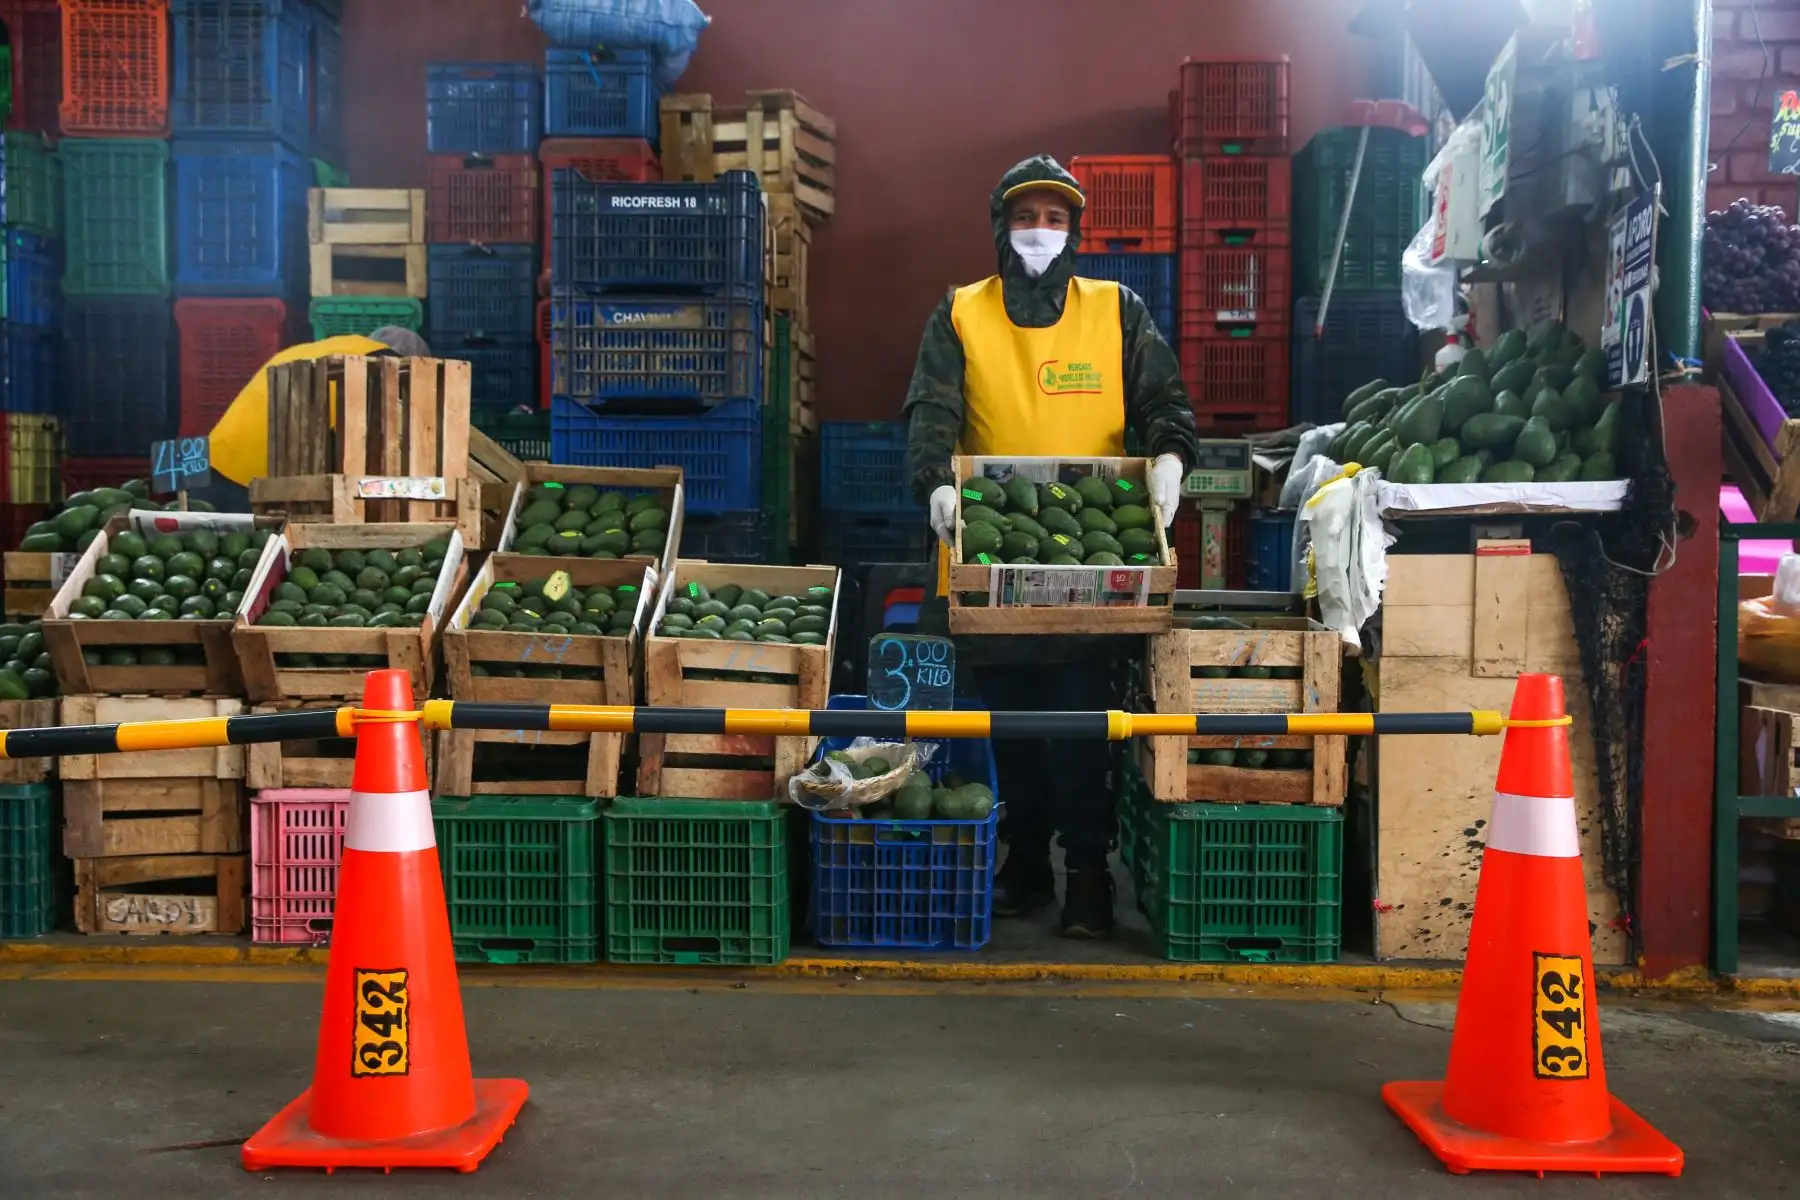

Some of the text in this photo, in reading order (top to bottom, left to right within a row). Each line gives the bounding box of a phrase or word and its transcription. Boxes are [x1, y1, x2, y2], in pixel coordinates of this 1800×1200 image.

[611, 195, 681, 208] RICOFRESH
[684, 196, 697, 208] 18
[916, 668, 951, 687] KILO
[360, 979, 406, 1070] 342
[1541, 970, 1583, 1073] 342
